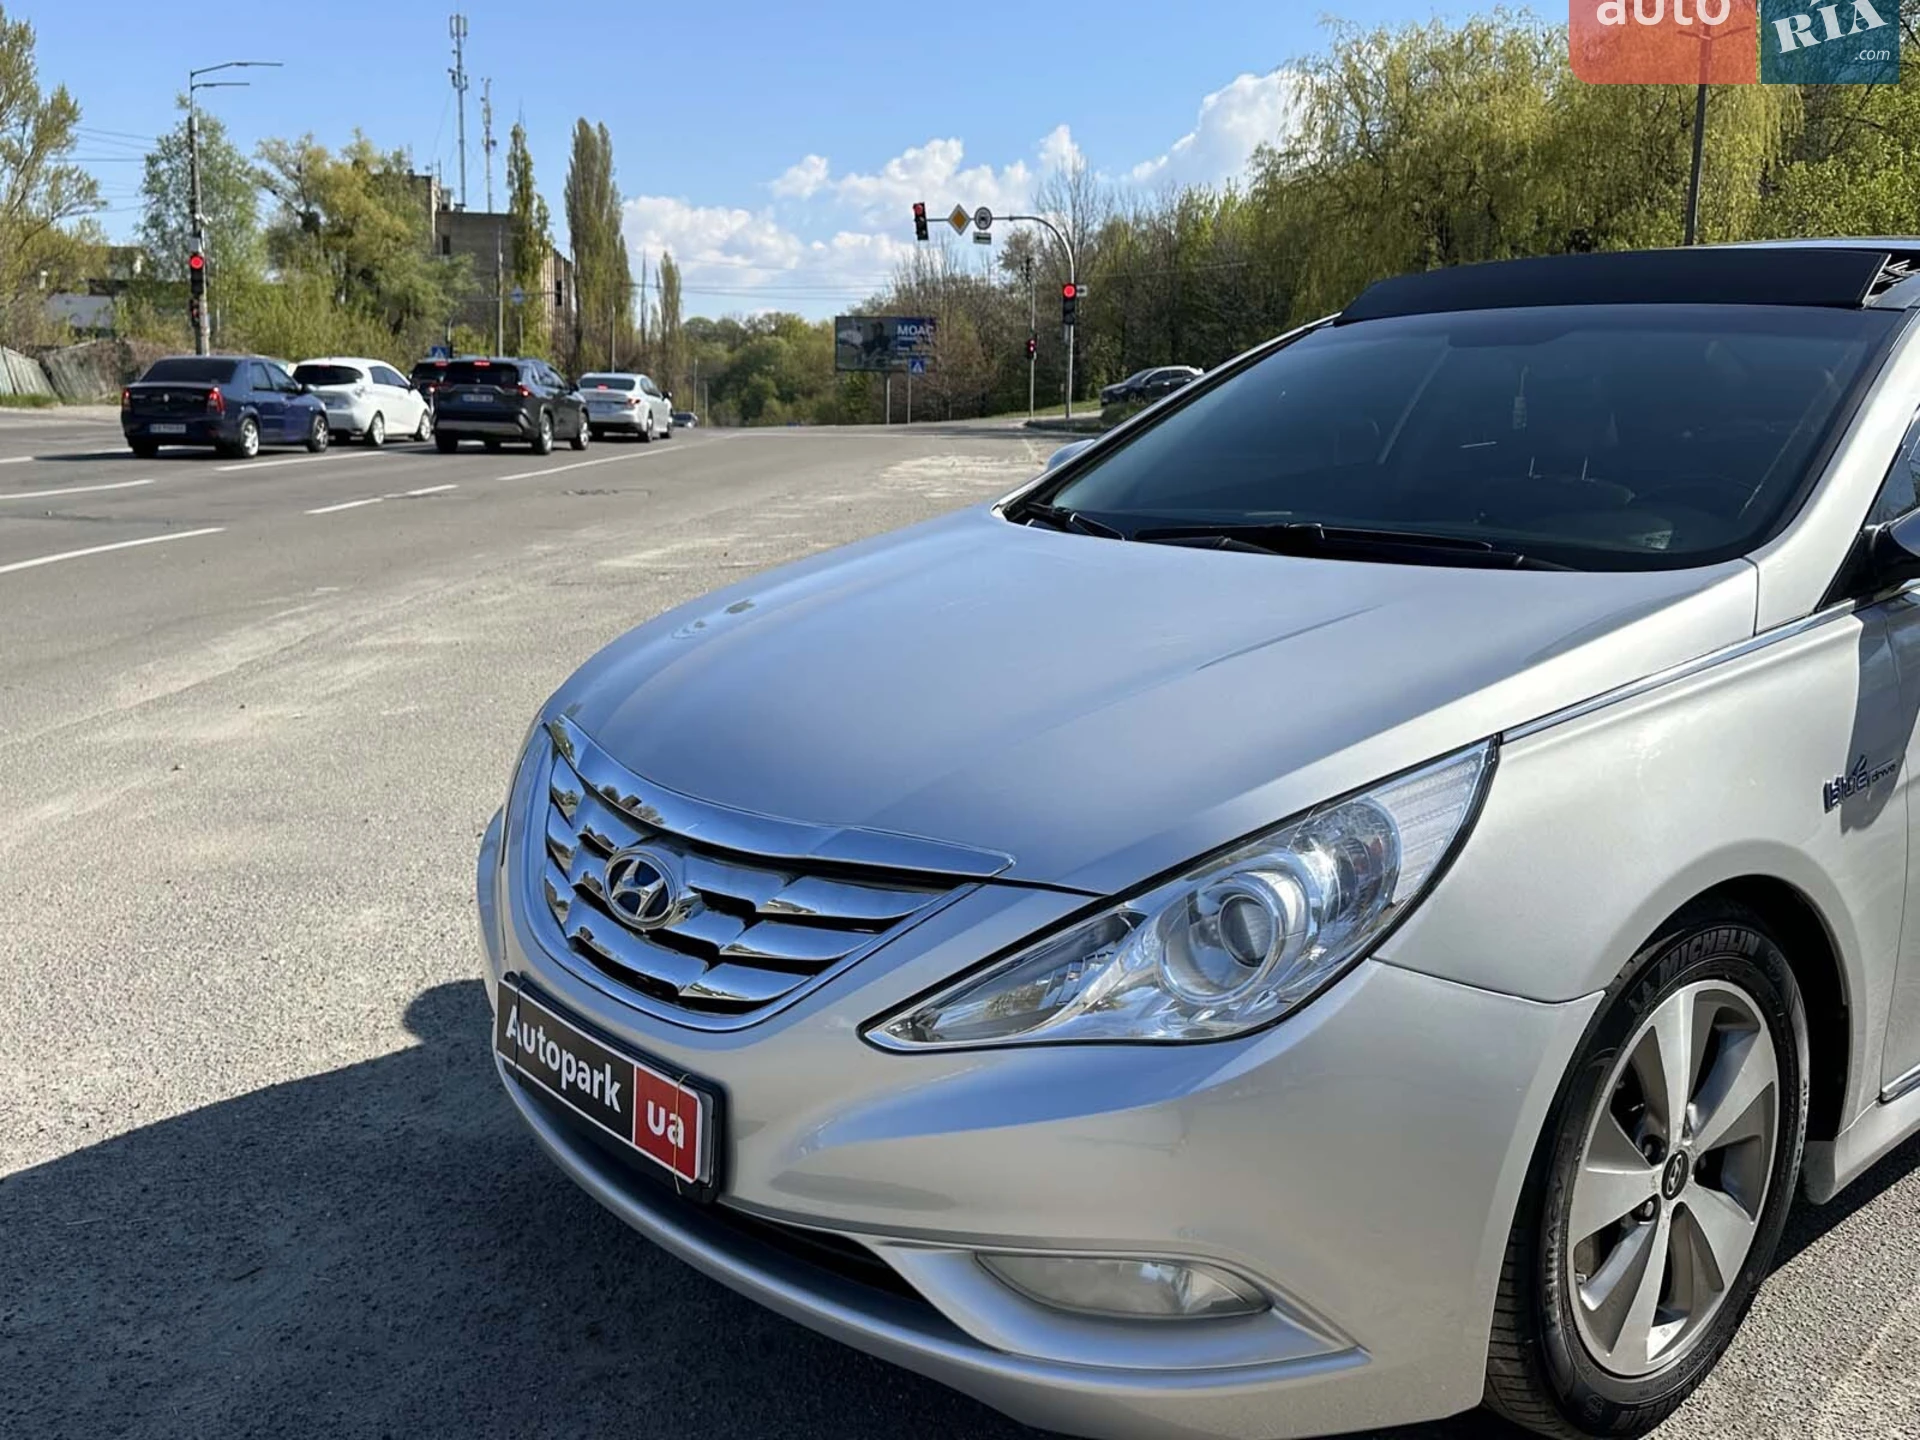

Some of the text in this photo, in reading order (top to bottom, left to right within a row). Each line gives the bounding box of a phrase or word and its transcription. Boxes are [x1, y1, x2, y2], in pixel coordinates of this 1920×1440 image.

[1659, 929, 1760, 987] MICHELIN
[505, 1005, 684, 1150] Autopark ua
